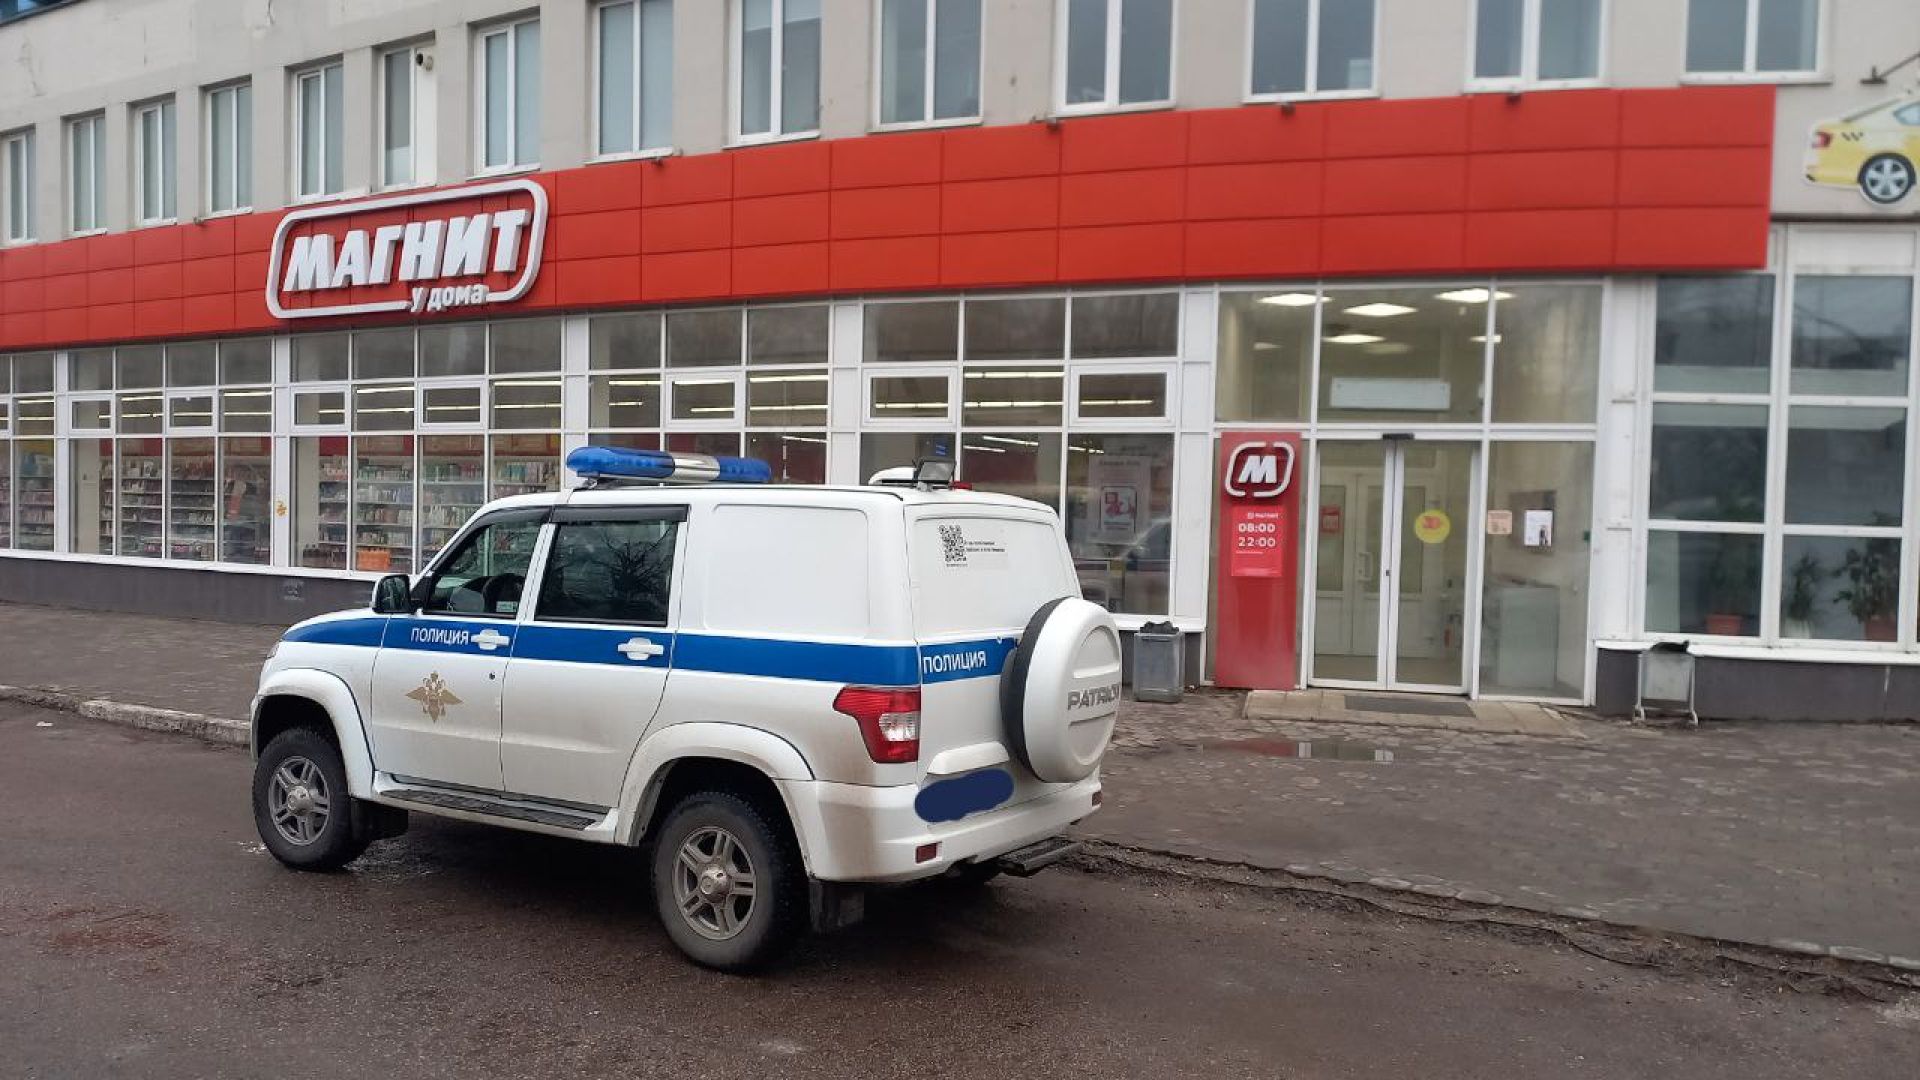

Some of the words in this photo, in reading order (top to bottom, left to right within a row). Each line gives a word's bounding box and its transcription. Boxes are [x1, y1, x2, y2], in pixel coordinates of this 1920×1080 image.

[283, 209, 529, 292] МАГНИТ
[410, 287, 428, 313] у
[427, 284, 490, 312] дома
[1238, 522, 1276, 533] 08:00
[1238, 536, 1276, 547] 22:00
[410, 627, 469, 646] ПОЛИЦИЯ
[923, 650, 987, 675] ПОЛИЦИЯ
[1067, 683, 1121, 711] PATRIO
